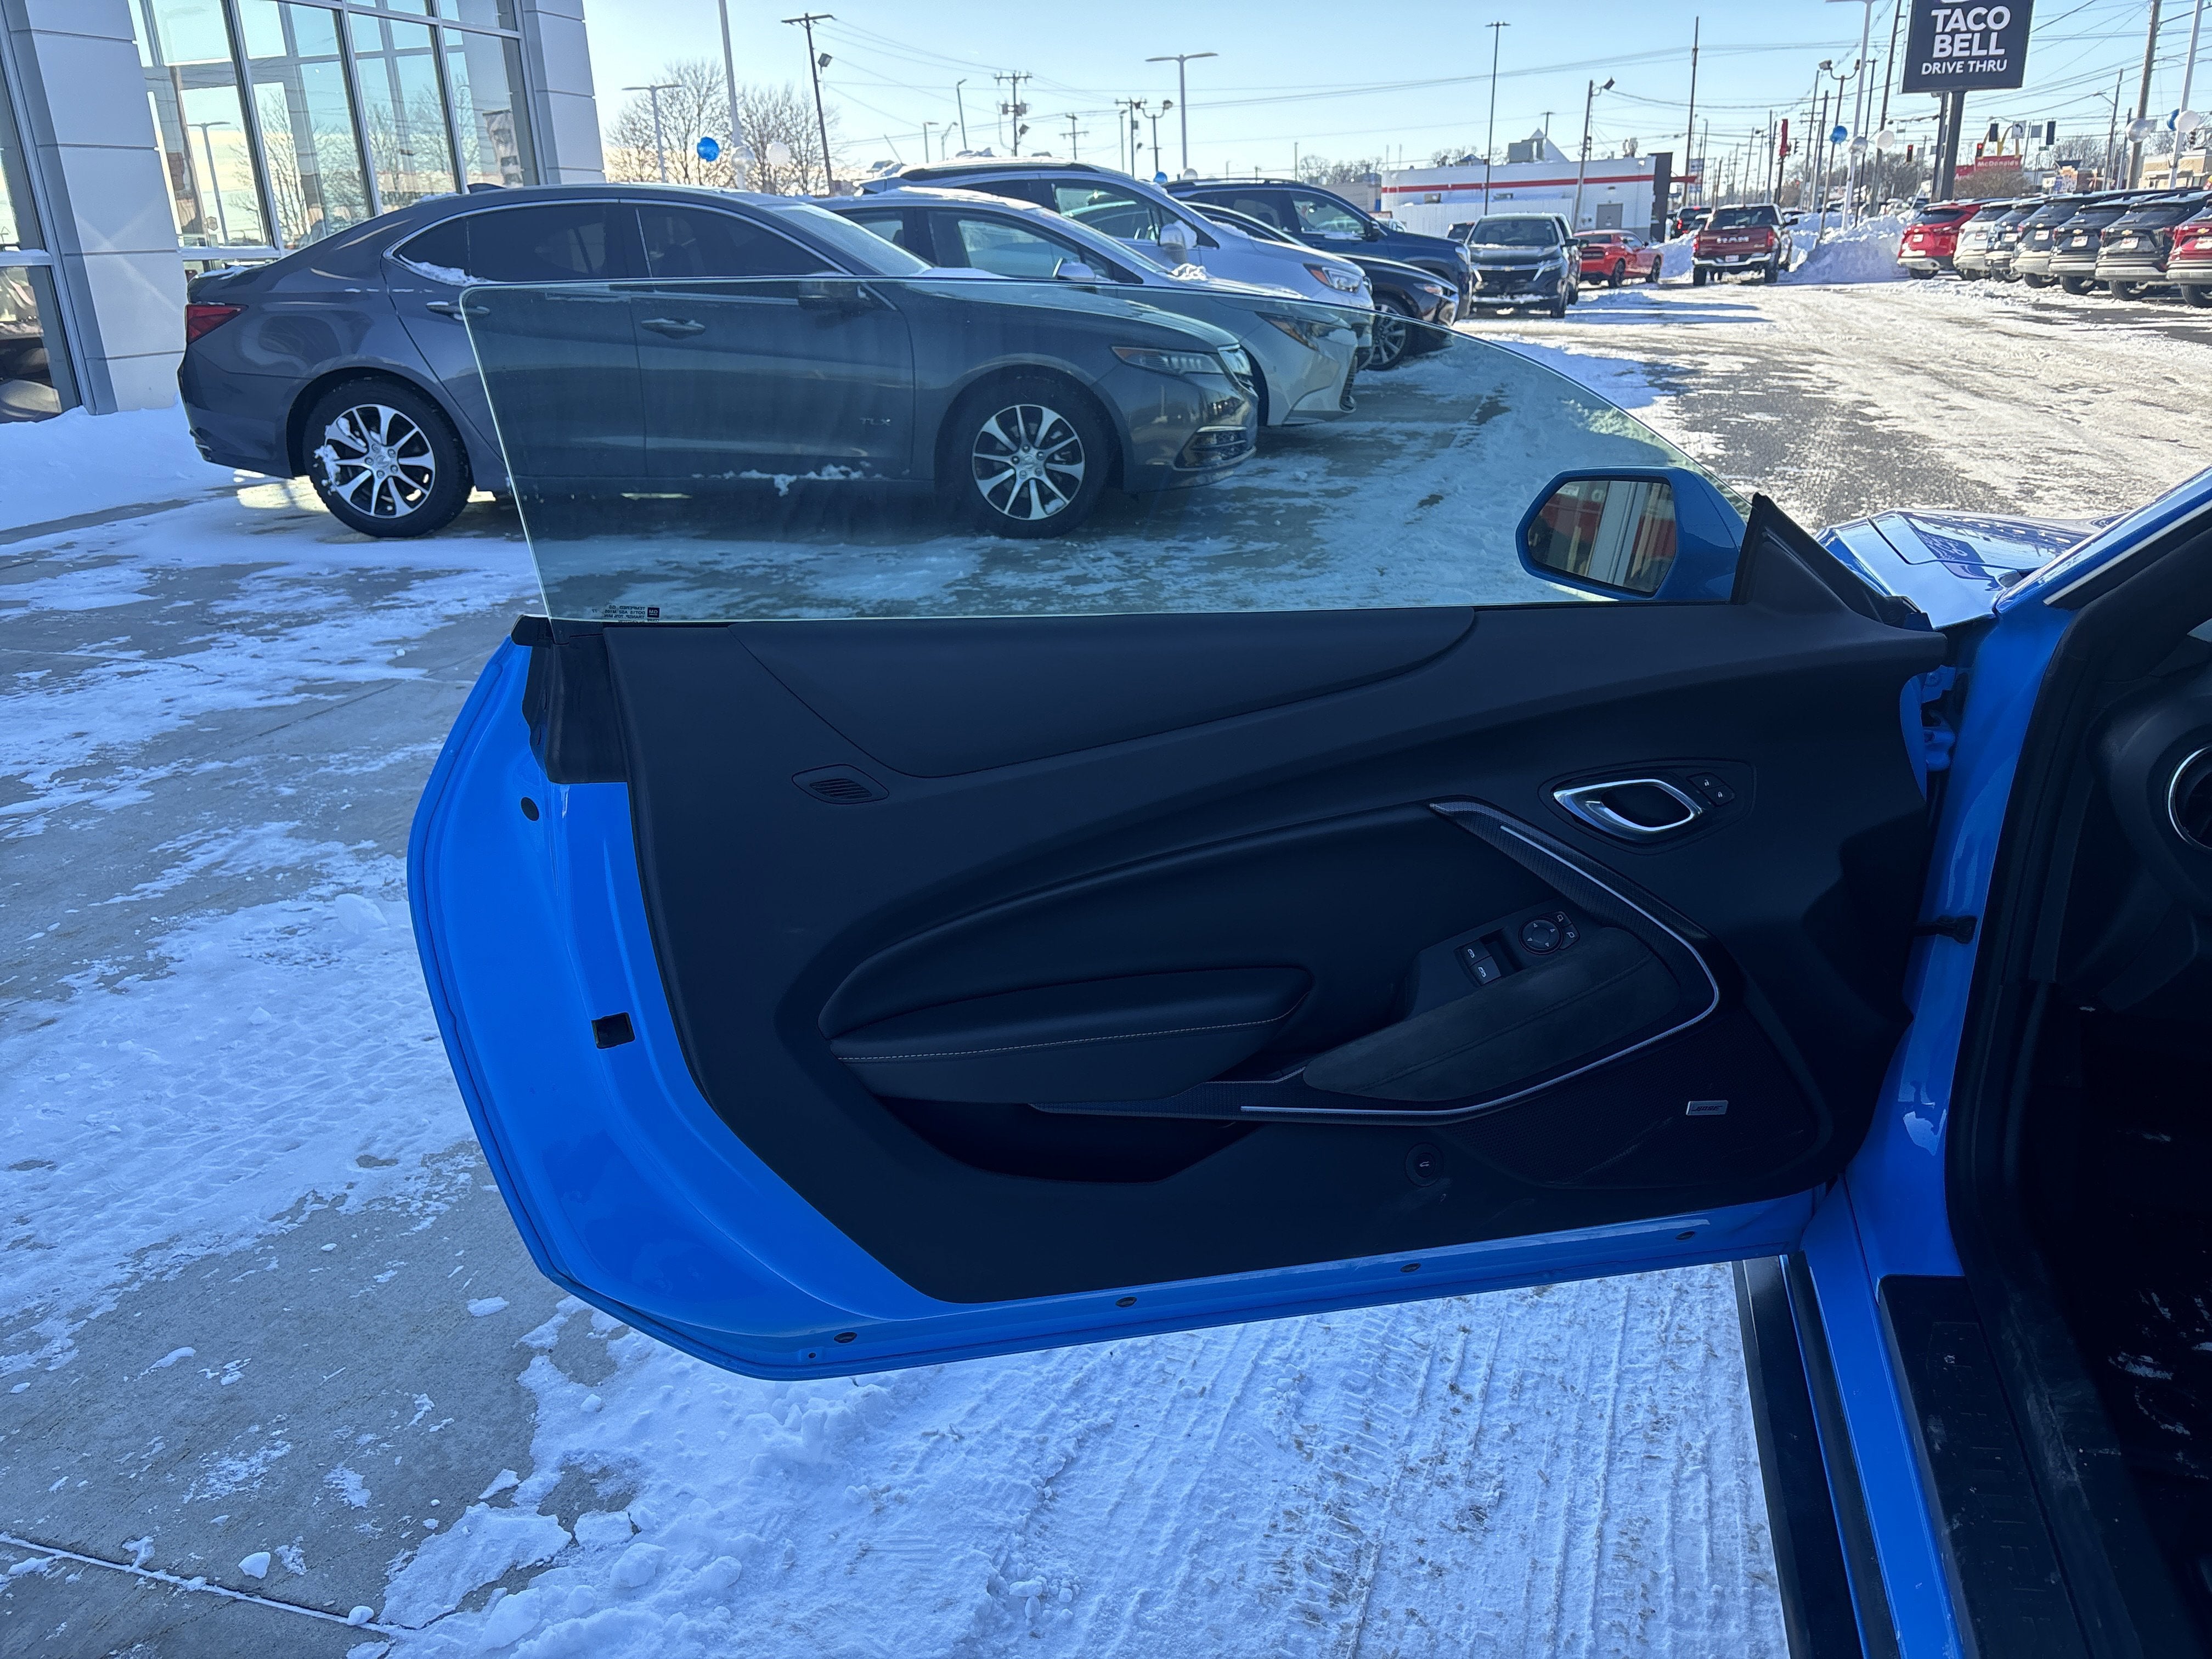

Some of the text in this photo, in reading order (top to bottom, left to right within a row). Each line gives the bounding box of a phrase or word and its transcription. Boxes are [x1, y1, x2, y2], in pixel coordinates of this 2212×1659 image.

[1931, 5, 2011, 32] TACO
[1933, 32, 2005, 58] BELL
[1922, 59, 2007, 75] DRIVE THRU
[1717, 236, 1750, 244] RAM
